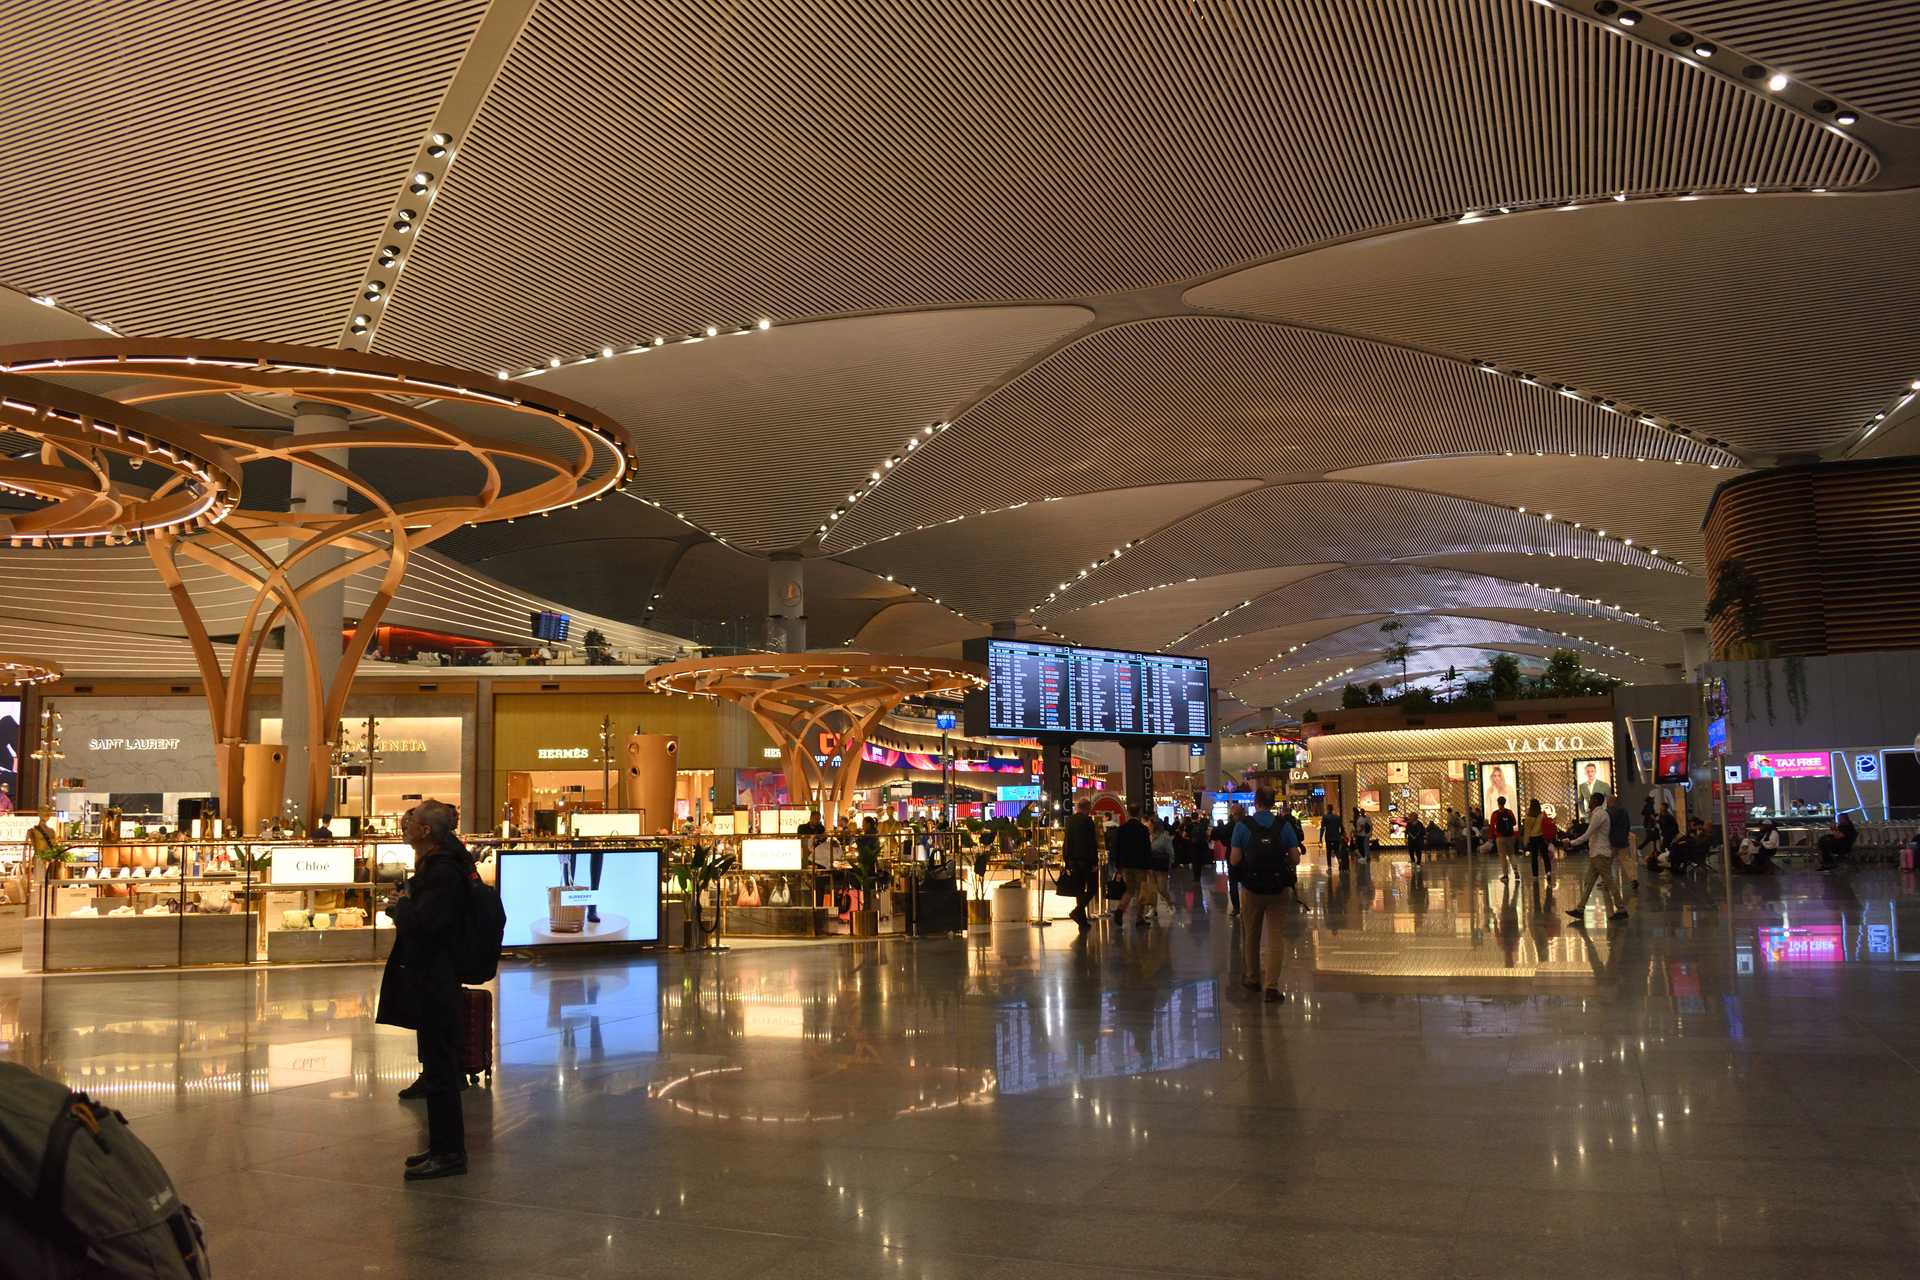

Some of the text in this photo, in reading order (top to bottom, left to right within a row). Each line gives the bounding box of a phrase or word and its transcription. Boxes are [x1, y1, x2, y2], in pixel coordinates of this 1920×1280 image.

[88, 738, 180, 751] SAINT LAURENT
[1505, 736, 1583, 752] VAKKO
[1775, 757, 1822, 767] TAX FREE
[1062, 766, 1070, 778] A
[1144, 766, 1152, 779] D
[1062, 782, 1070, 795] B
[1144, 782, 1151, 796] E
[1062, 798, 1071, 811] C
